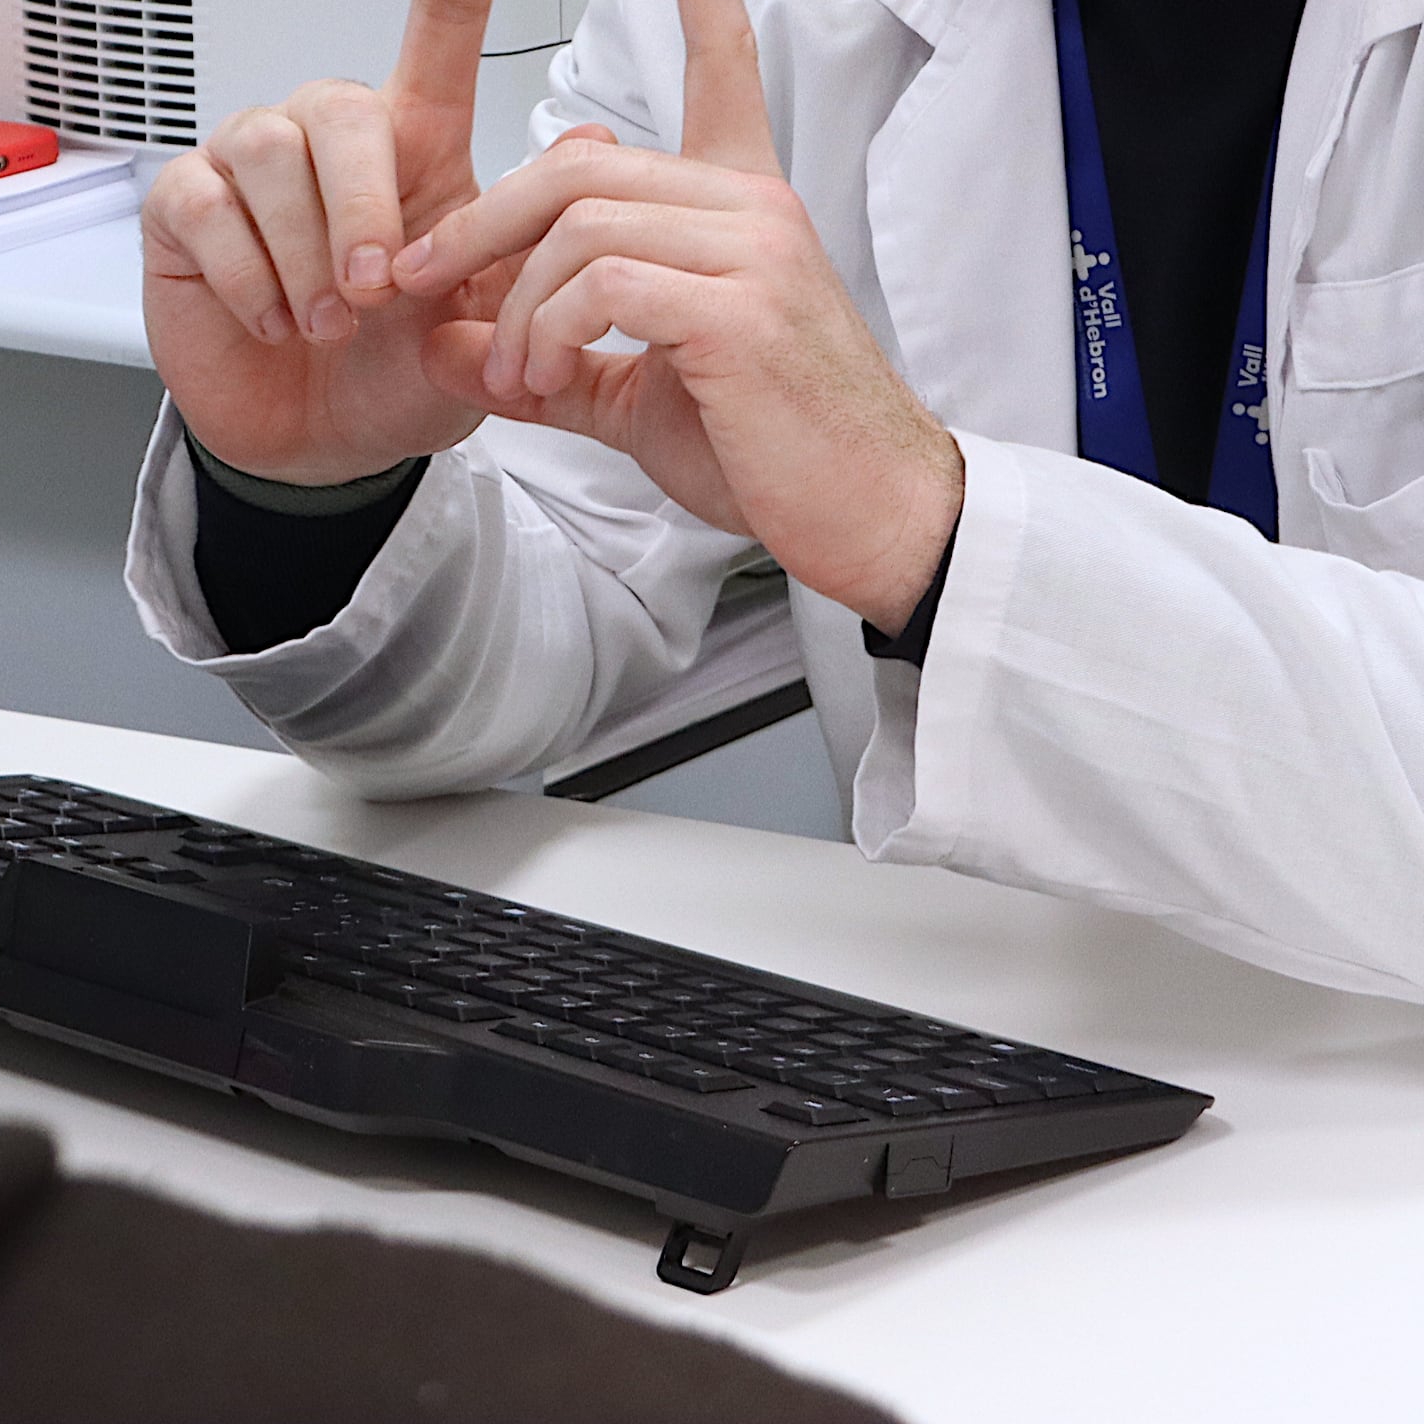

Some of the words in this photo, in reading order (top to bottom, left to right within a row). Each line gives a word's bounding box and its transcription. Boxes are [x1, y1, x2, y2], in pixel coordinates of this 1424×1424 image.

[1098, 281, 1122, 328] Vall
[1079, 286, 1107, 399] d'Hebron
[1237, 343, 1264, 387] Vall
